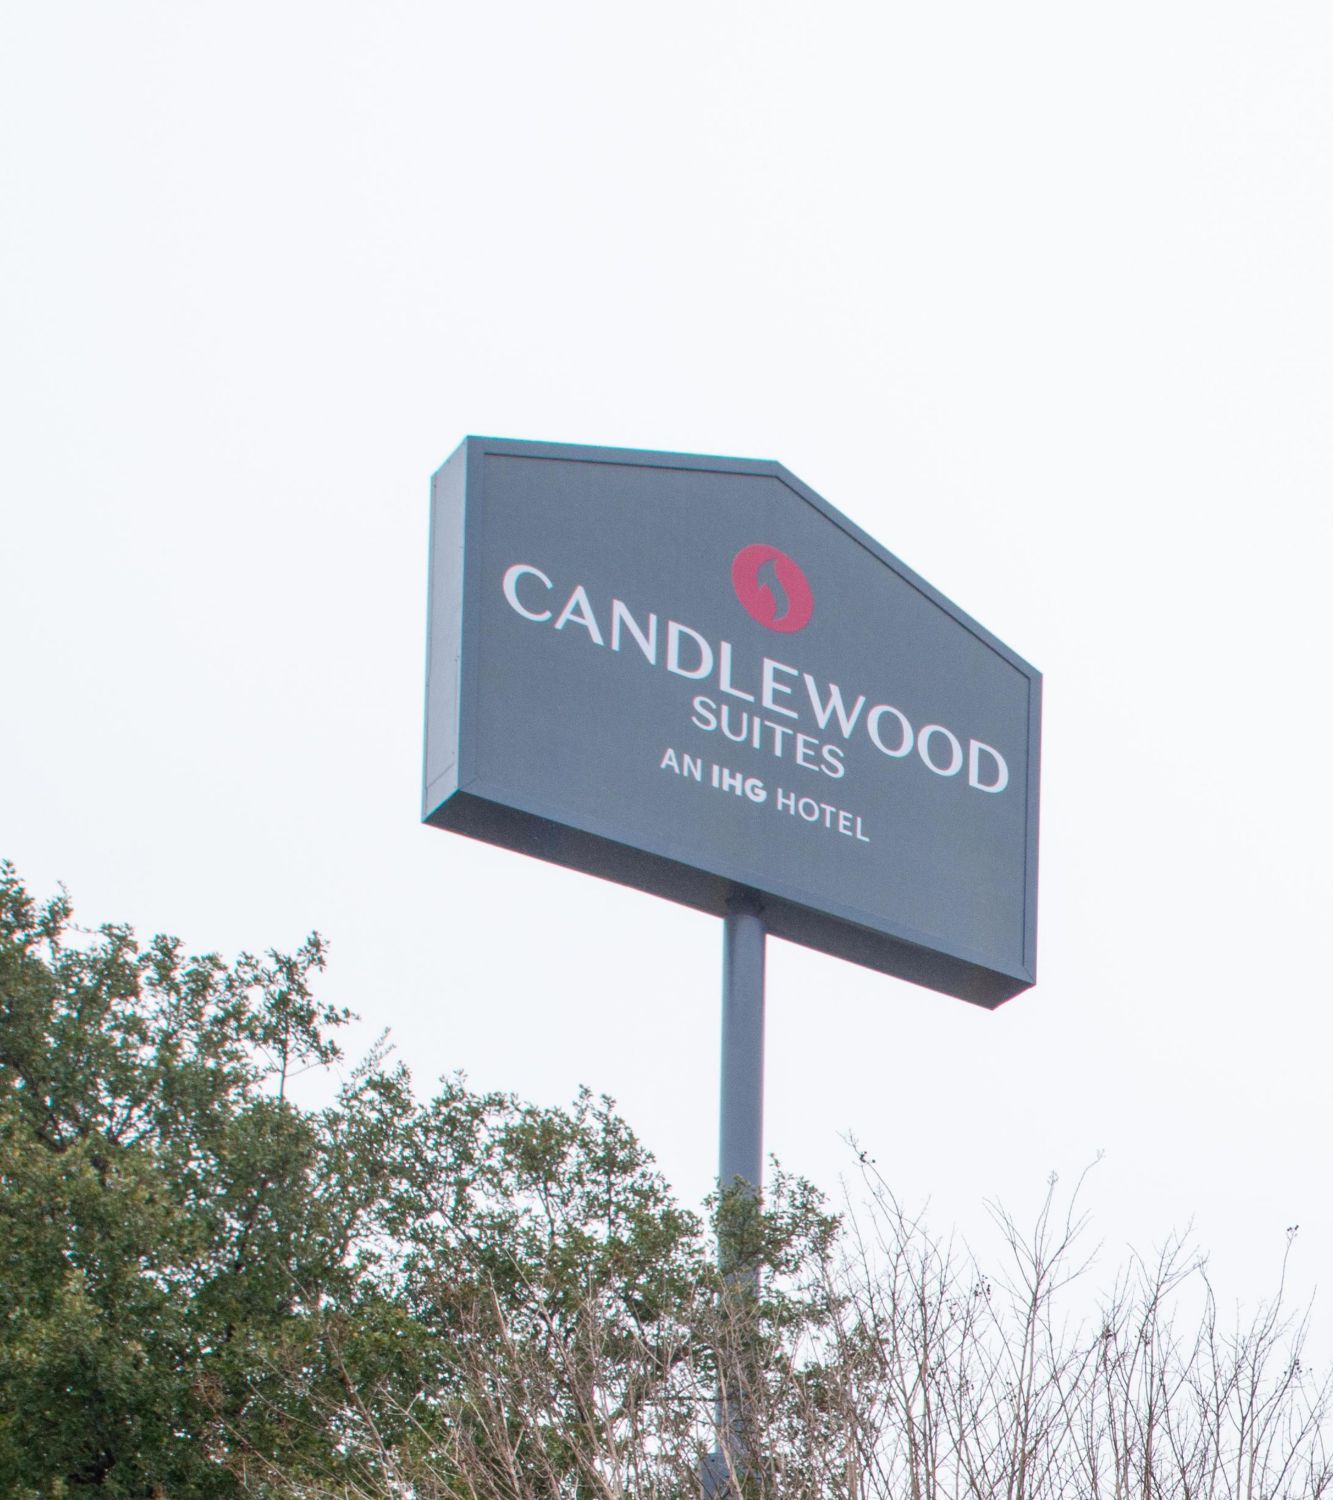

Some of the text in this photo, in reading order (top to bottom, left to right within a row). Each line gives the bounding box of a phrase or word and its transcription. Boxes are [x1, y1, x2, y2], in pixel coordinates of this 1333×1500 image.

[502, 564, 1009, 793] CANDLEWOOD
[691, 695, 845, 778] SUITES
[660, 747, 870, 842] AN IHG HOTEL
